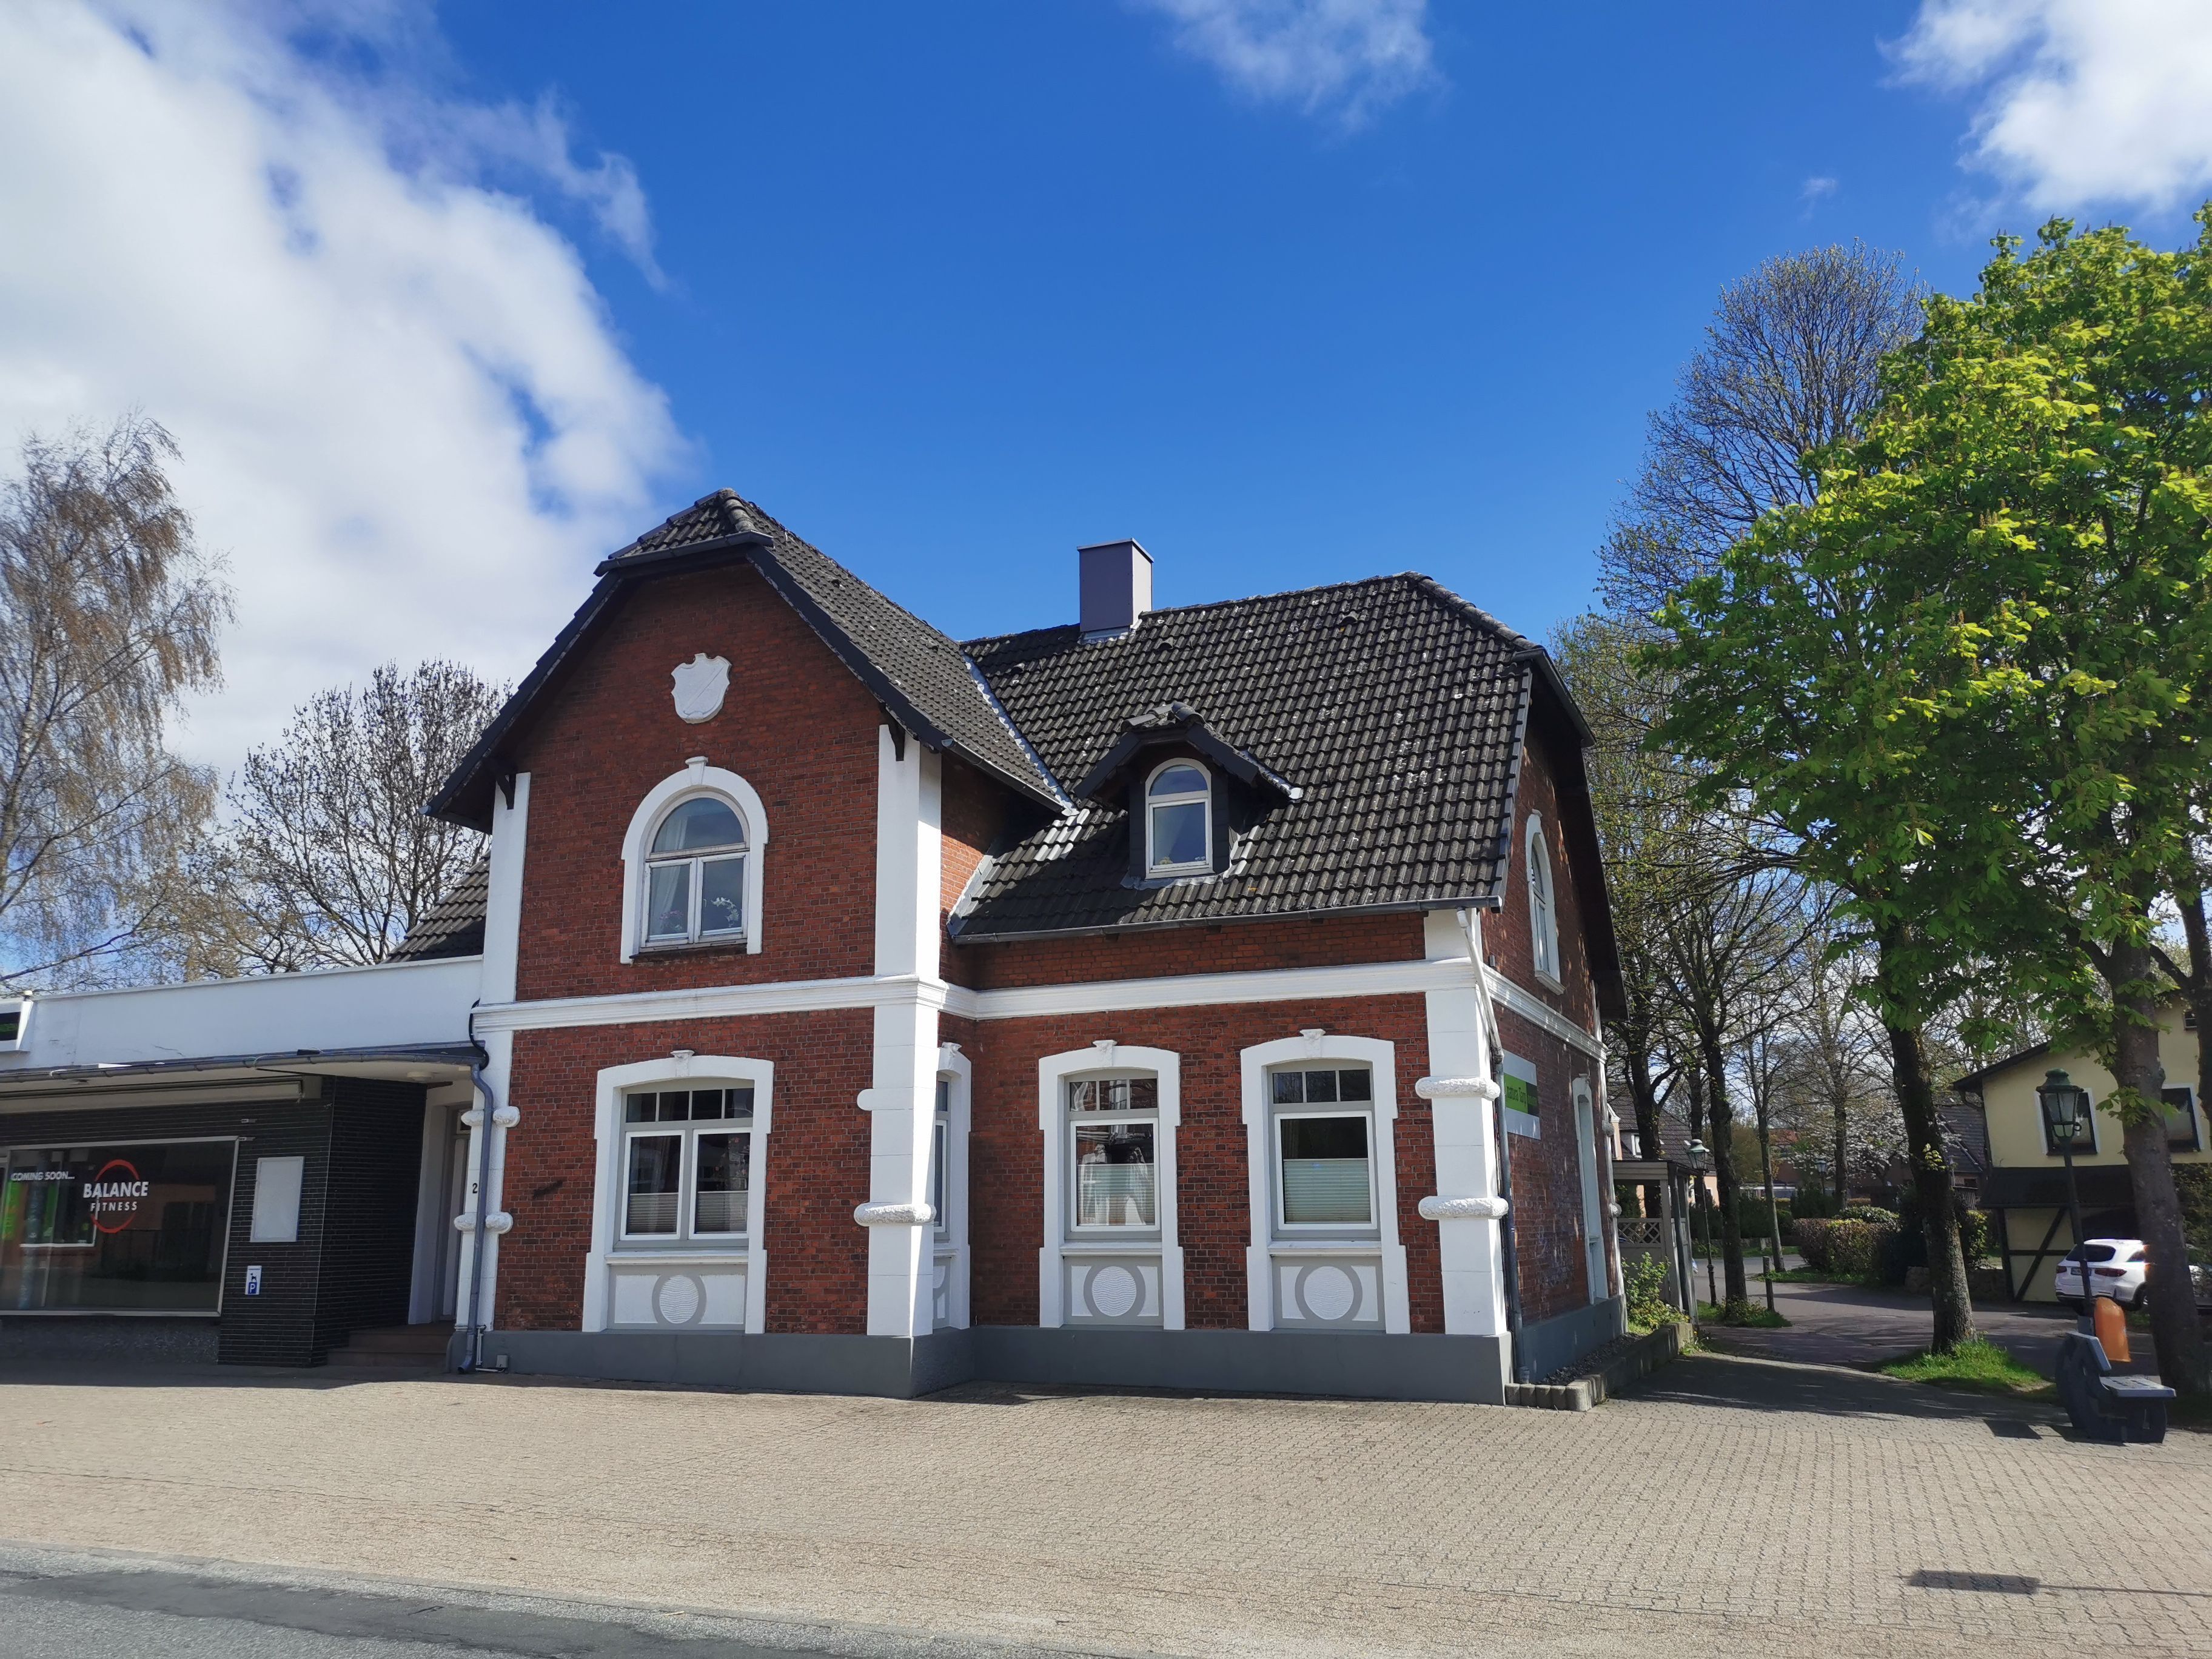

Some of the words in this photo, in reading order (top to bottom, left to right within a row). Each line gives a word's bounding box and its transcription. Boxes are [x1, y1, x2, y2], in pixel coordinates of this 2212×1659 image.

[10, 1172, 44, 1181] COMING
[83, 1181, 149, 1198] BALANCE
[472, 1182, 478, 1193] 2
[90, 1201, 138, 1212] FITNESS
[249, 1283, 255, 1293] P
